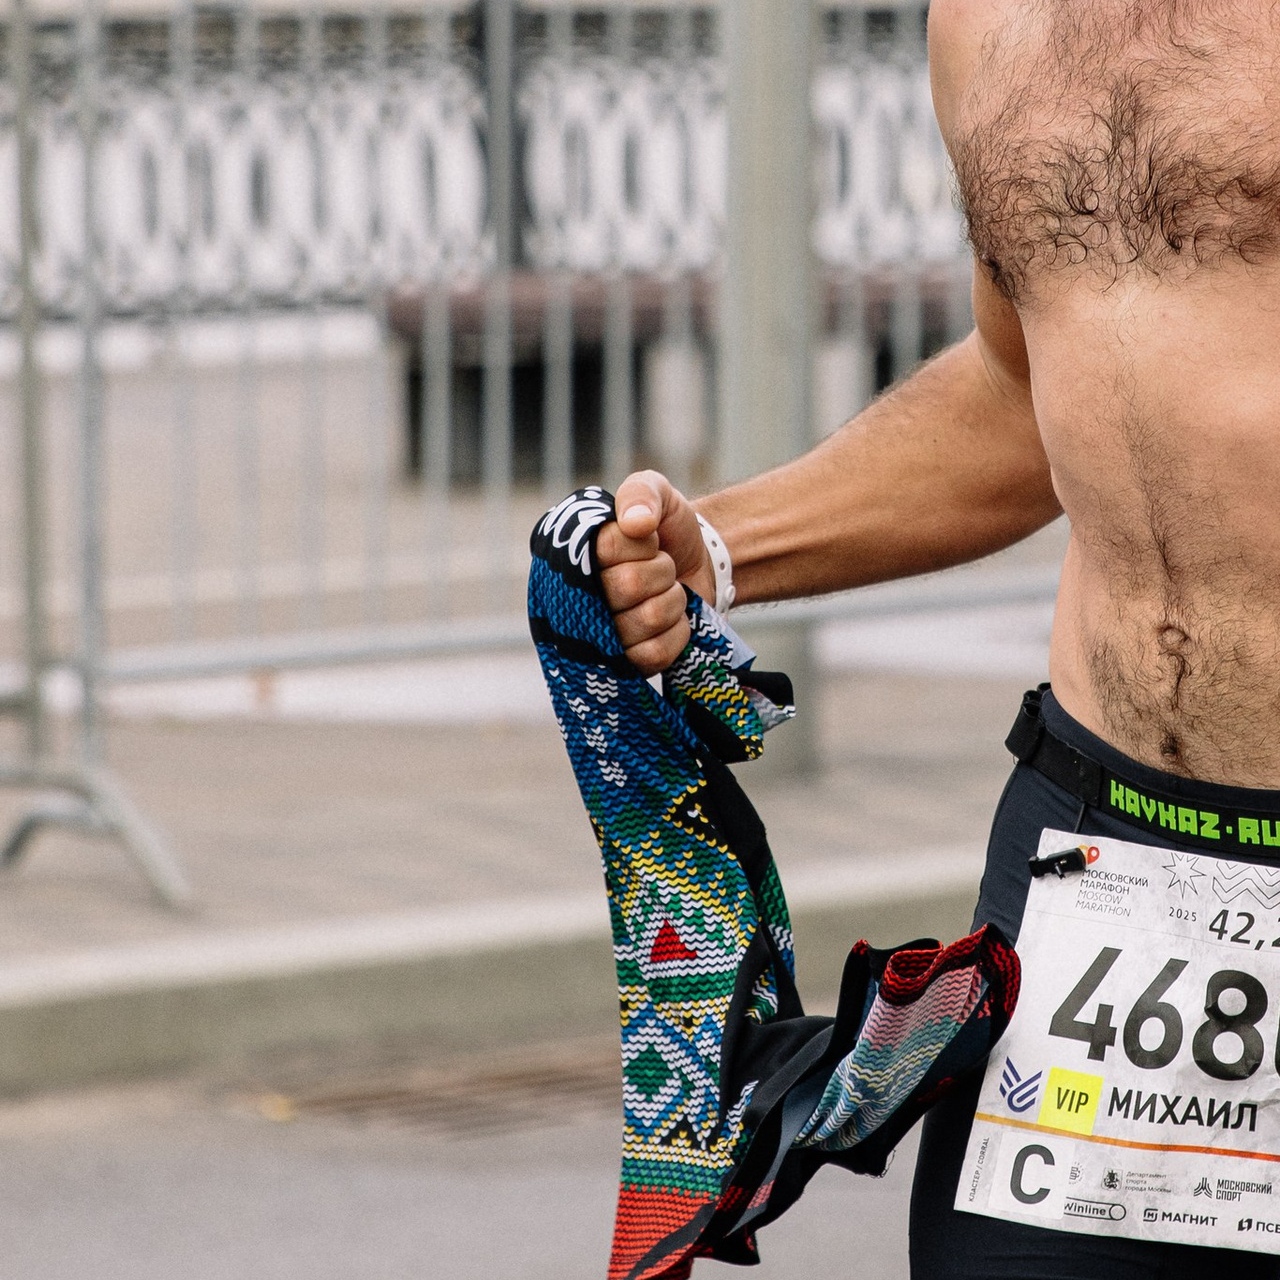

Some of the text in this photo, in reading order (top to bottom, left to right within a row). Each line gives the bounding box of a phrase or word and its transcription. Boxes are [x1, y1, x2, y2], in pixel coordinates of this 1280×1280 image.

[1080, 878, 1130, 895] МАРАФОН
[1081, 868, 1149, 888] МОСКОВСКИЙ
[1077, 889, 1123, 904] MOSCOW
[1075, 900, 1131, 917] MARATHON
[1169, 906, 1197, 922] 2025
[1056, 1087, 1089, 1114] VIP
[1108, 1086, 1258, 1132] МИХАИЛ
[968, 1170, 981, 1203] КЛАСТЕР
[978, 1137, 990, 1165] CORRAL
[1010, 1144, 1055, 1205] C
[1216, 1178, 1273, 1195] МОСКОВСКИЙ
[1215, 1190, 1242, 1202] СПОРТ
[1161, 1211, 1218, 1227] МАГНИТ
